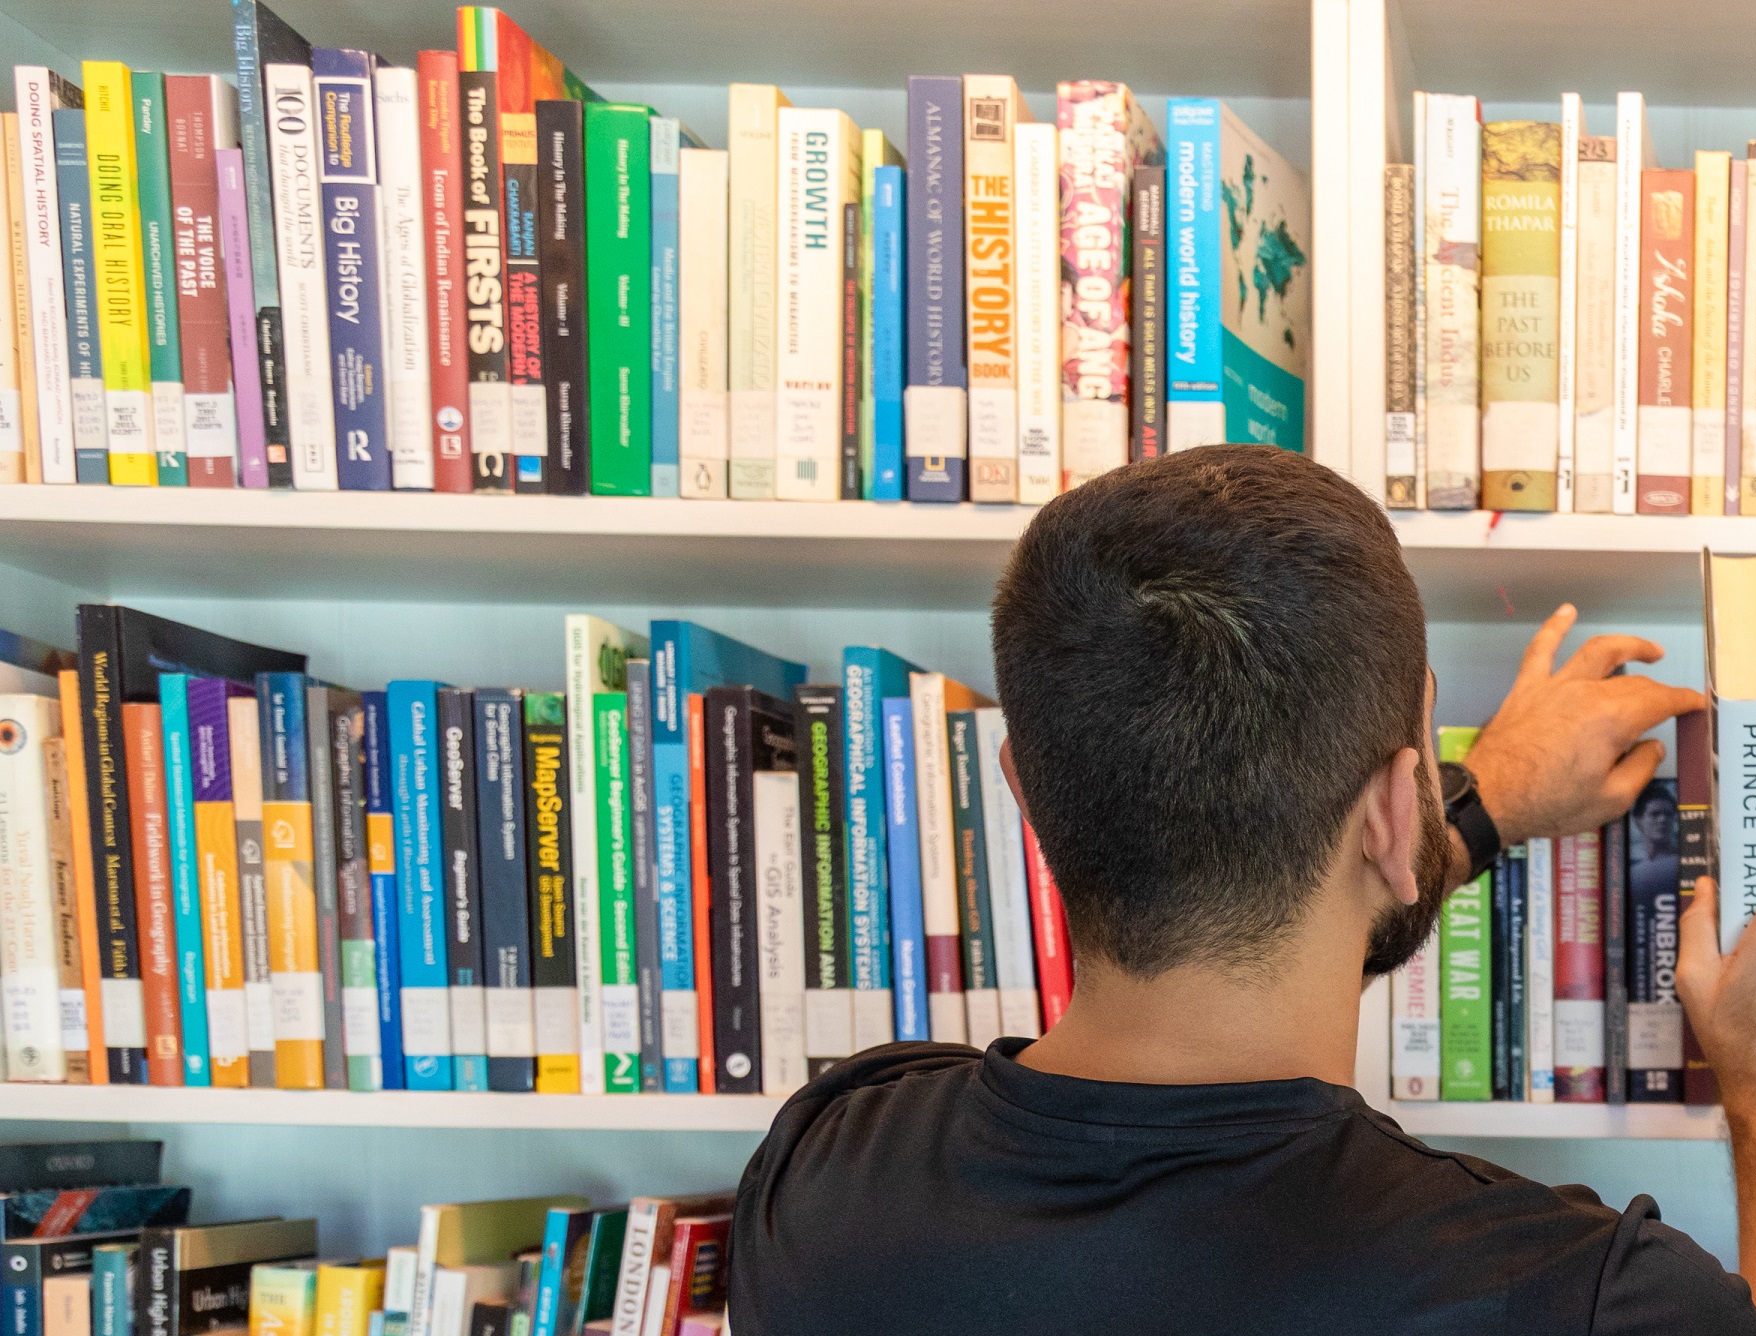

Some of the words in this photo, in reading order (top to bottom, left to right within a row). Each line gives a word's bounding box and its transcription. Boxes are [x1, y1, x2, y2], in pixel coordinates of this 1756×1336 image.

[142, 99, 152, 134] Pandey
[469, 88, 487, 122] The
[97, 155, 123, 202] DOING
[276, 88, 305, 135] 100
[294, 145, 314, 268] DOCUMENTS
[470, 127, 488, 178] Book
[1179, 141, 1199, 221] modern
[178, 206, 193, 228] OF
[331, 197, 360, 234] Big
[472, 181, 490, 204] of
[805, 132, 828, 249] GROWTH
[1485, 194, 1556, 212] ROMILA
[101, 212, 130, 250] ORAL
[179, 233, 195, 260] THE
[198, 216, 213, 247] THE
[1488, 215, 1554, 232] THAPAR
[180, 261, 199, 297] PAST
[199, 246, 217, 289] VOICE
[337, 242, 362, 324] History
[466, 210, 503, 353] FIRSTS
[972, 202, 1010, 357] HISTORY
[1180, 227, 1199, 286] world
[105, 260, 131, 325] HISTORY
[1652, 251, 1686, 336] Ashoka
[1176, 292, 1200, 363] history
[845, 665, 866, 795] GEOGRAPHICAL
[446, 726, 464, 810] GeoServer
[811, 721, 830, 831] GEOGRAPHIC
[532, 747, 562, 871] MapServer
[850, 798, 868, 911] INFORMATION
[816, 834, 834, 951] INFORMATION
[853, 915, 871, 990] SYSTEMS
[1450, 950, 1480, 999] WAR
